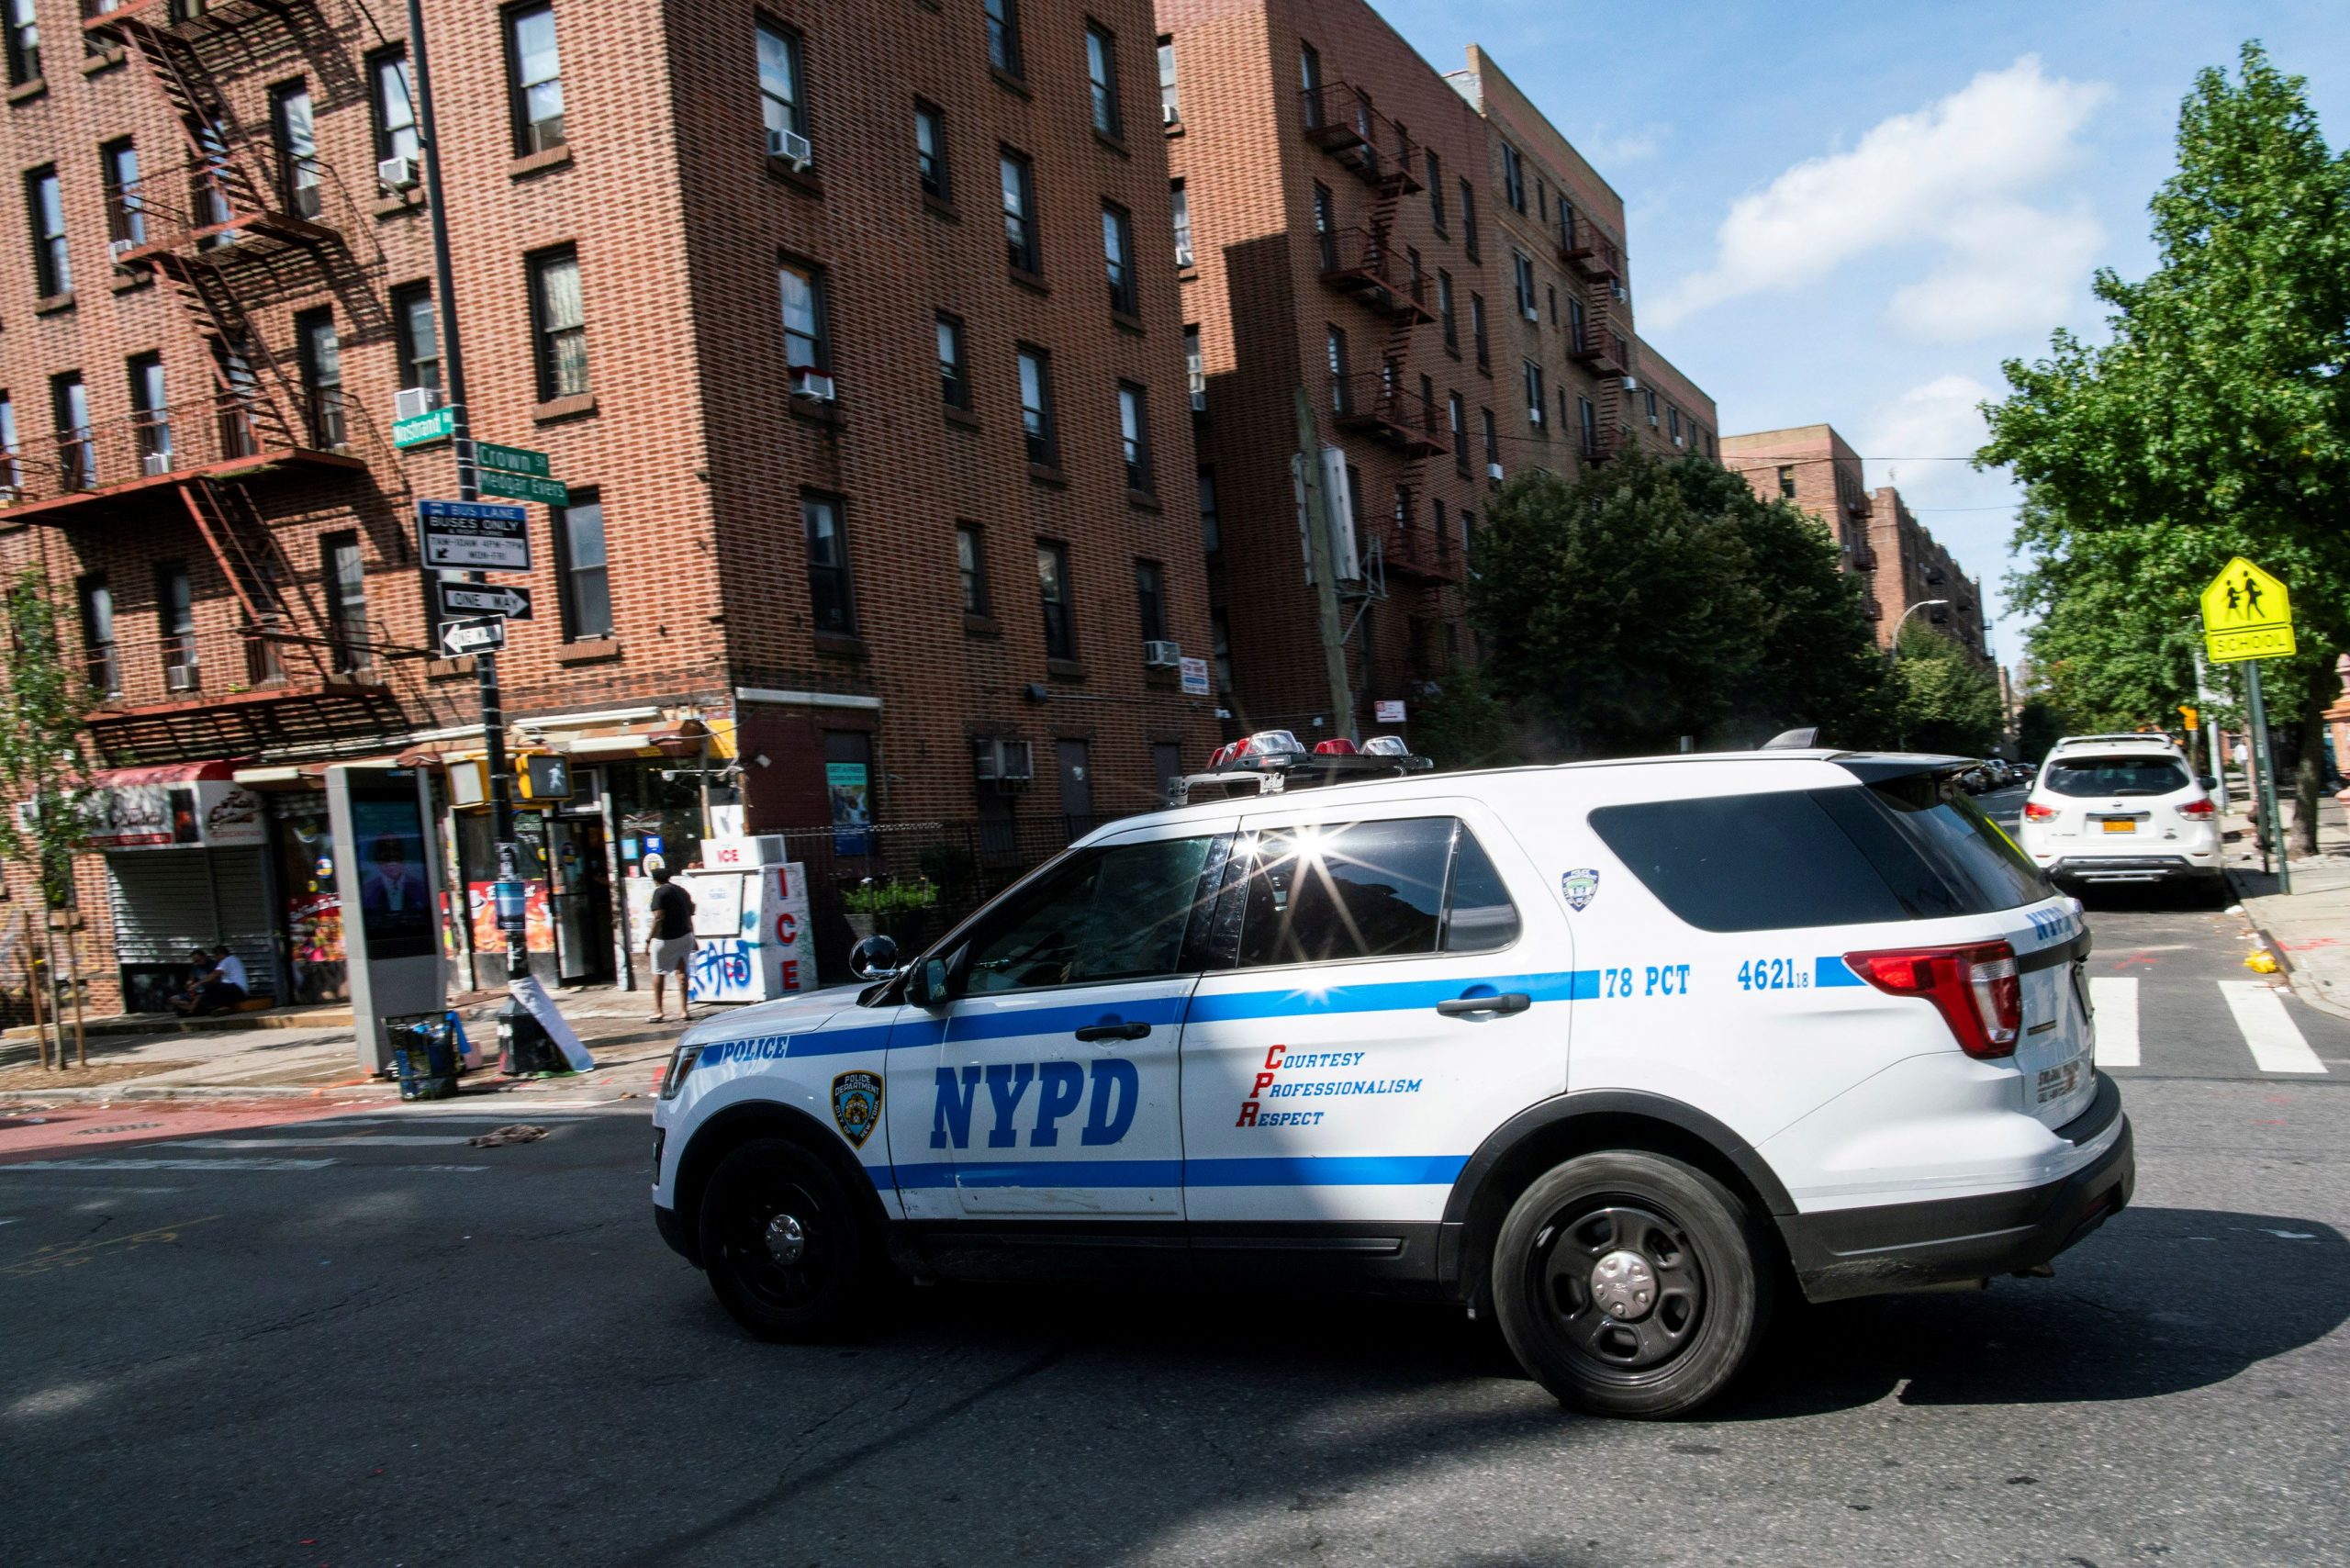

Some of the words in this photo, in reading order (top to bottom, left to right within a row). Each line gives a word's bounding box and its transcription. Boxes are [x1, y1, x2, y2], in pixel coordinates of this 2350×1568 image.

[478, 446, 531, 471] Crown
[481, 471, 527, 495] Medgar
[531, 478, 566, 498] Evers
[430, 516, 478, 529] BUSES
[482, 520, 520, 531] ONLY
[451, 505, 477, 516] BUS
[481, 509, 517, 520] LANE
[454, 592, 480, 606] ONE
[491, 596, 520, 610] WAY
[2216, 633, 2286, 653] SCHOOL
[718, 849, 739, 863] ICE
[776, 867, 801, 993] ICE
[1606, 967, 1633, 999] 78
[1645, 965, 1690, 996] PCT
[1738, 958, 1795, 991] 4621
[722, 1036, 788, 1063] POLICE
[1264, 1045, 1365, 1070] COURTESY
[834, 1081, 880, 1097] DEPARTMENT
[845, 1073, 871, 1083] POLICE
[1248, 1071, 1423, 1099] PROFESSIONALISM
[930, 1058, 1139, 1148] NYPD
[1235, 1102, 1325, 1127] RESPECT
[834, 1104, 845, 1123] CITY
[843, 1126, 852, 1136] OF
[859, 1122, 872, 1138] NEW
[869, 1100, 880, 1121] YORK
